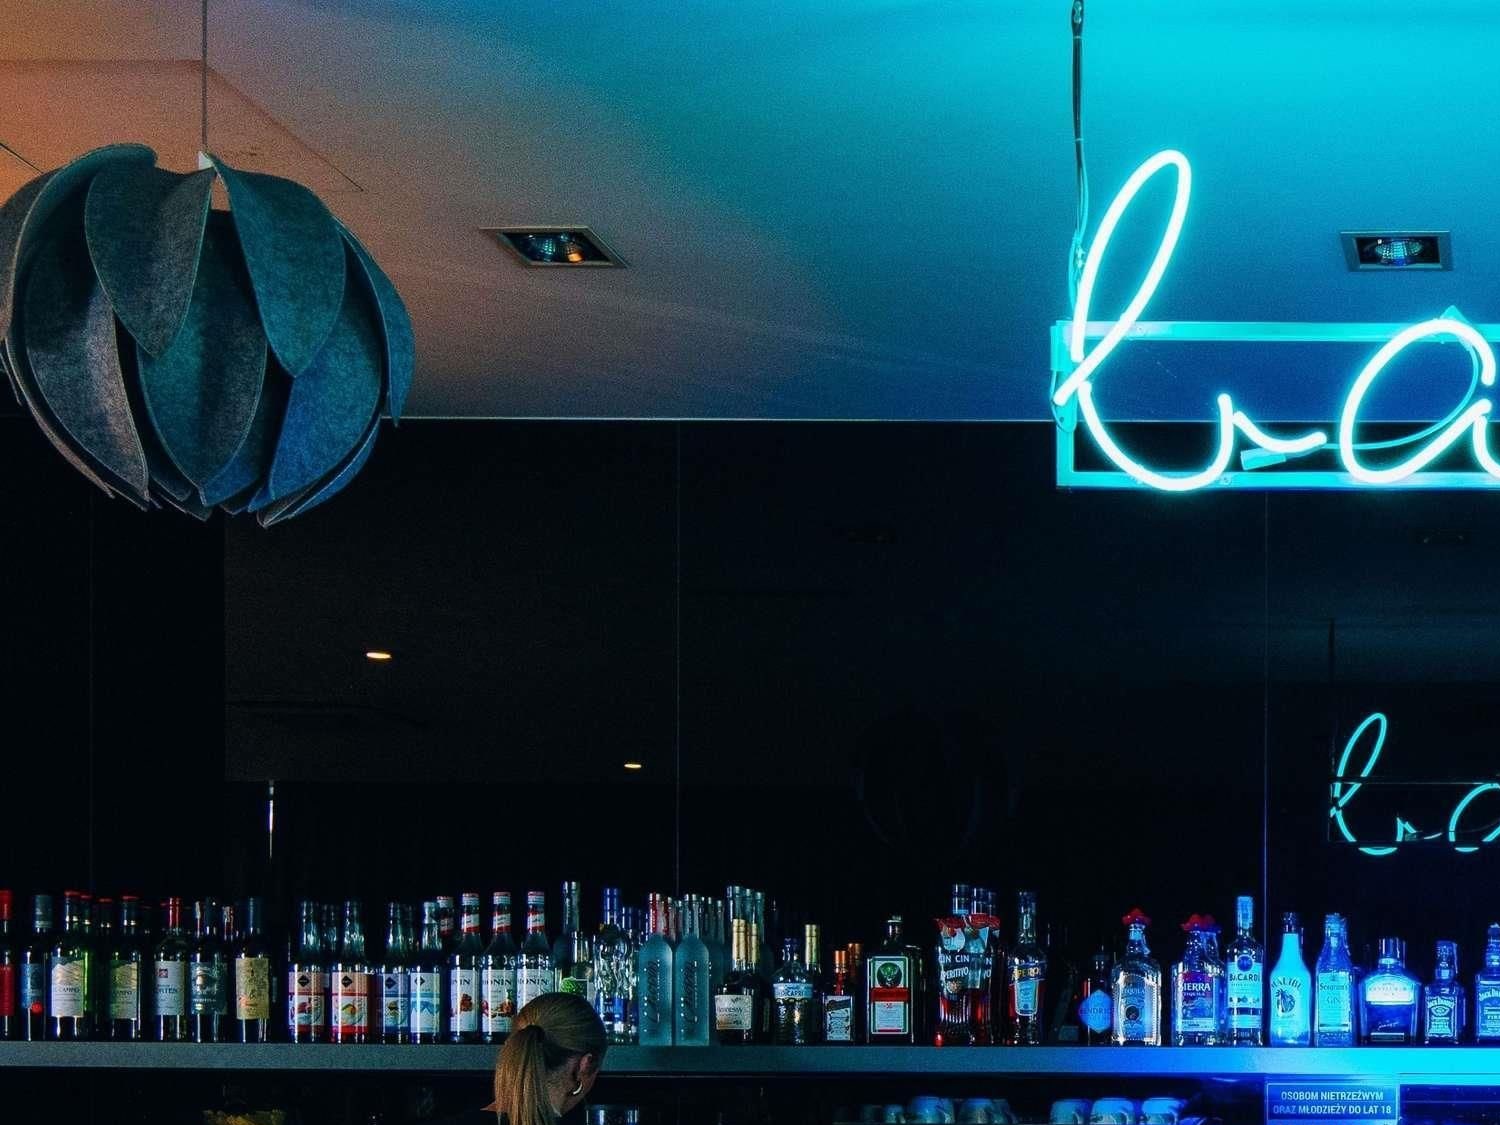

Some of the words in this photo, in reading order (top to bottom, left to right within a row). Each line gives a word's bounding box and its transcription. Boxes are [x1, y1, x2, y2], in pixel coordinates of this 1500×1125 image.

[1281, 1091, 1318, 1101] OSOBOM
[1273, 1105, 1296, 1115] ORAZ
[1348, 1105, 1361, 1115] DO
[1363, 1105, 1379, 1115] LAT
[1381, 1105, 1392, 1115] 18
